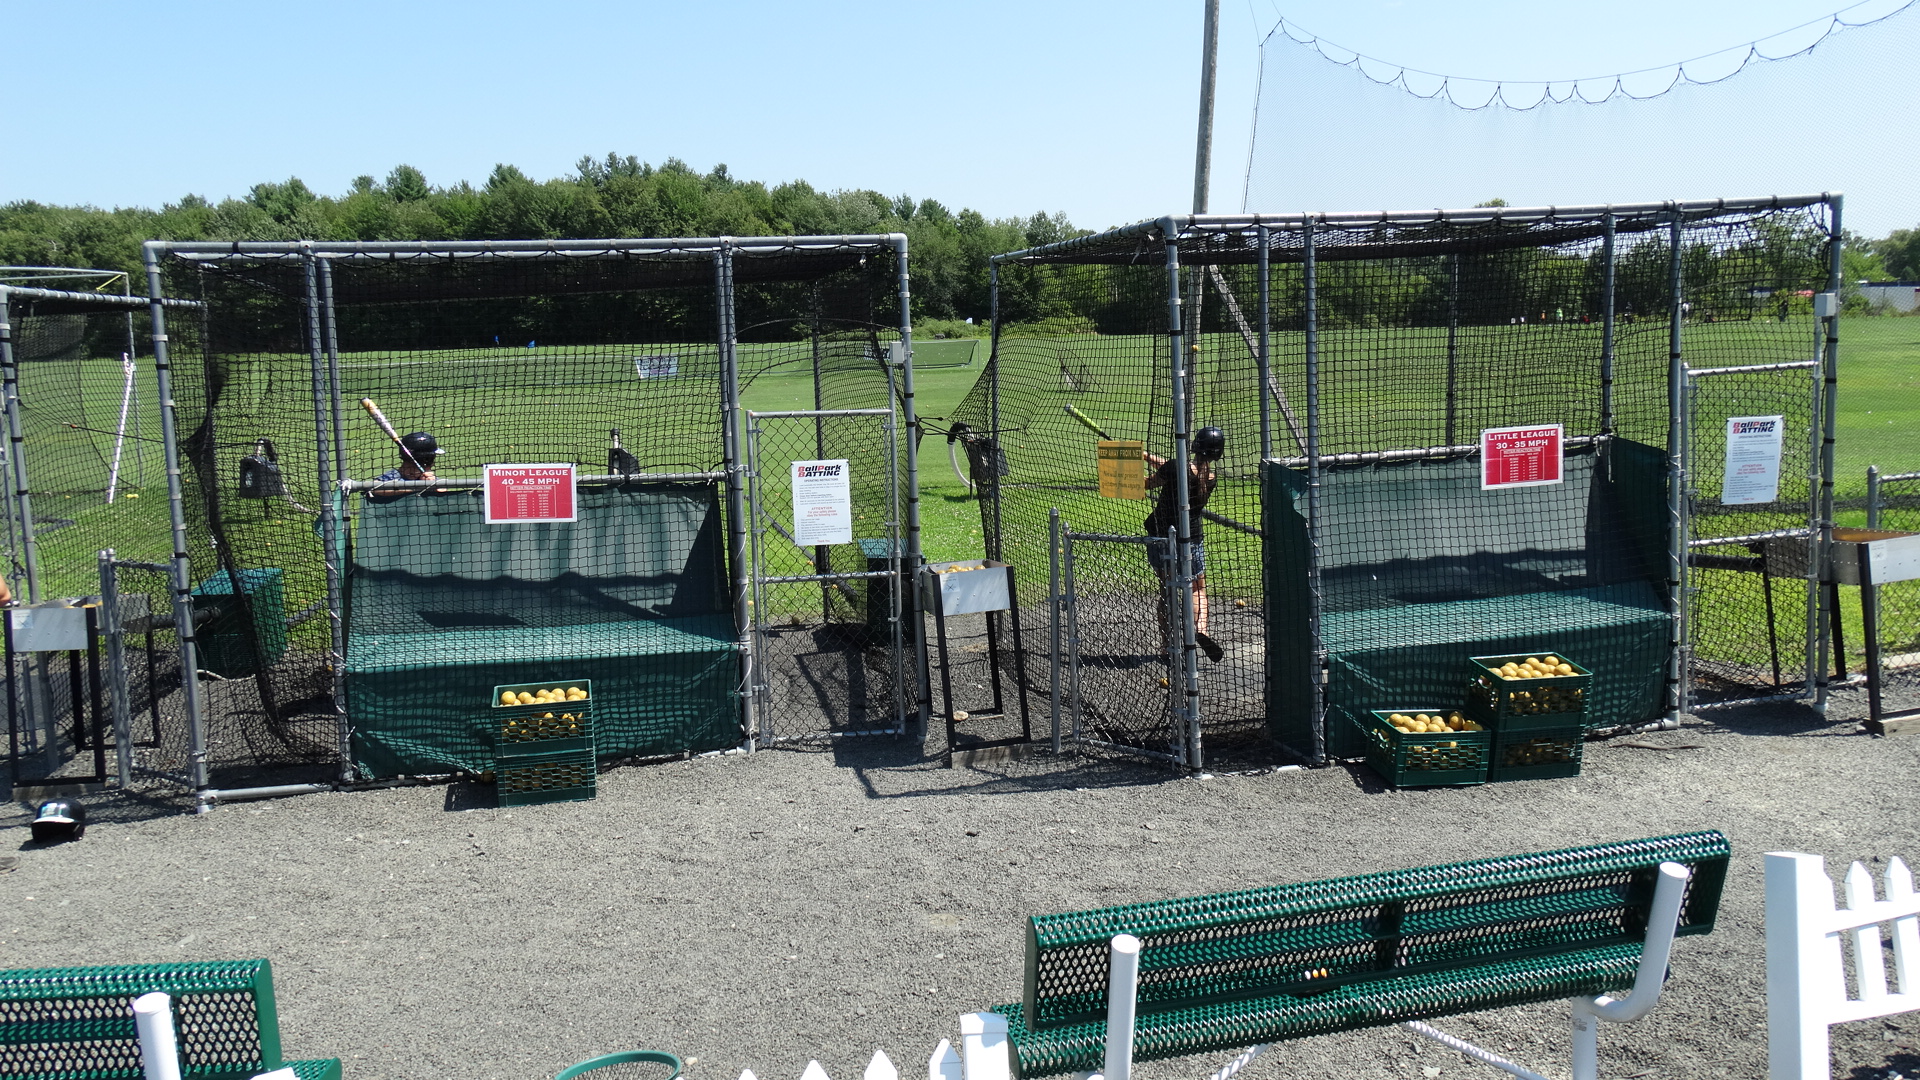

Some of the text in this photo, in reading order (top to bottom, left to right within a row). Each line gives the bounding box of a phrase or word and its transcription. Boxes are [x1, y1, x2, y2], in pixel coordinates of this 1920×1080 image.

[1733, 420, 1776, 428] BallPark
[1488, 430, 1556, 440] LITTLE LEAGUE
[1528, 439, 1548, 447] MPH
